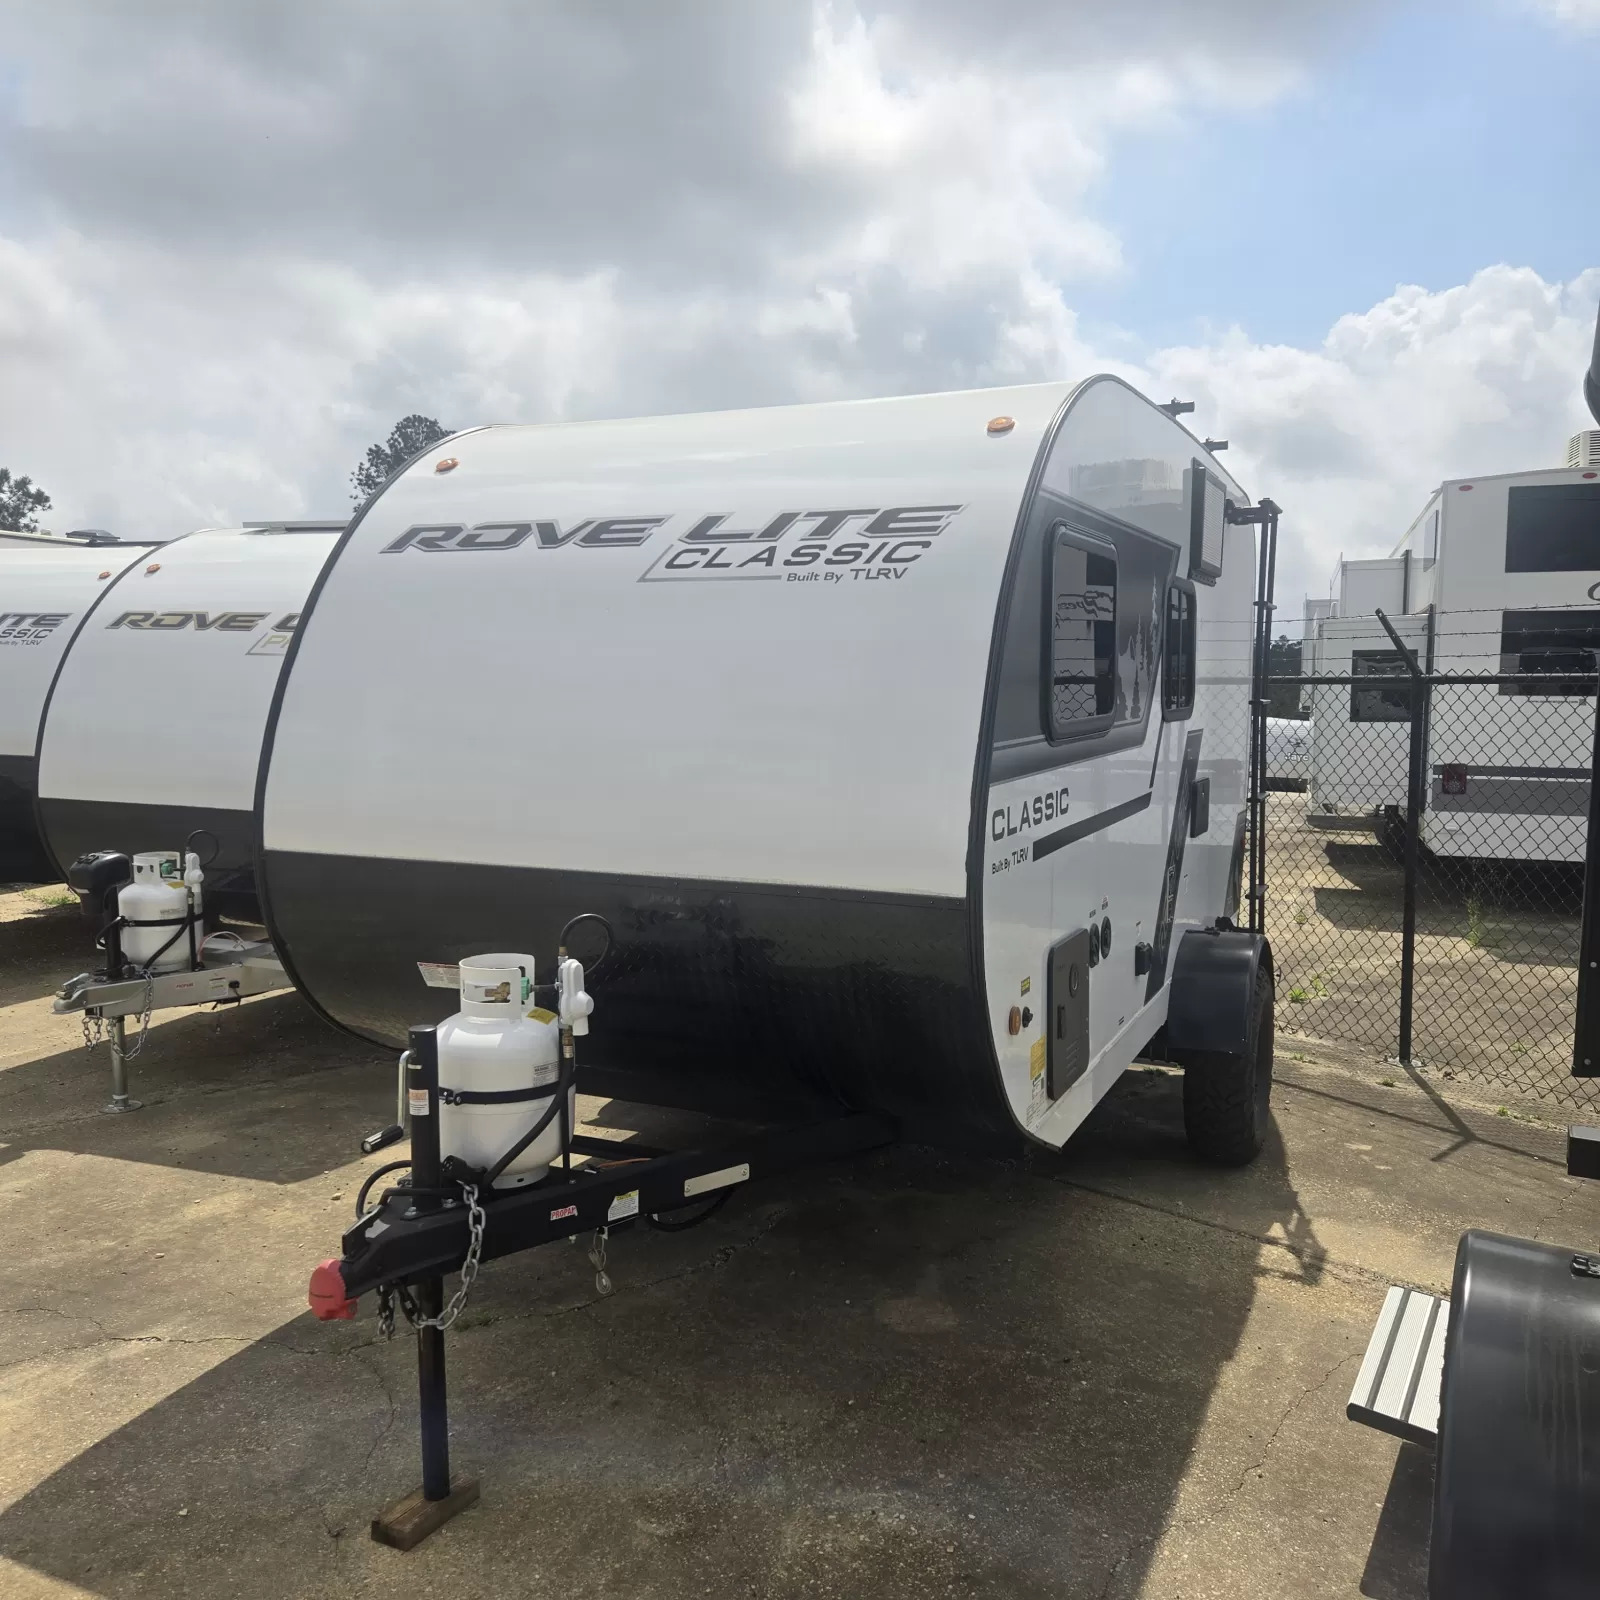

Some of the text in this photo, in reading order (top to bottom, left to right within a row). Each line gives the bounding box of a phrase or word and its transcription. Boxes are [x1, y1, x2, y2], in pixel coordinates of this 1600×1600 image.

[379, 503, 970, 554] ROVE LITE
[664, 540, 932, 569] CLASSIC
[786, 567, 908, 584] Built By TLRV
[105, 611, 272, 631] ROVE
[992, 787, 1070, 842] CLASSIC
[992, 846, 1029, 875] Built By TLRV
